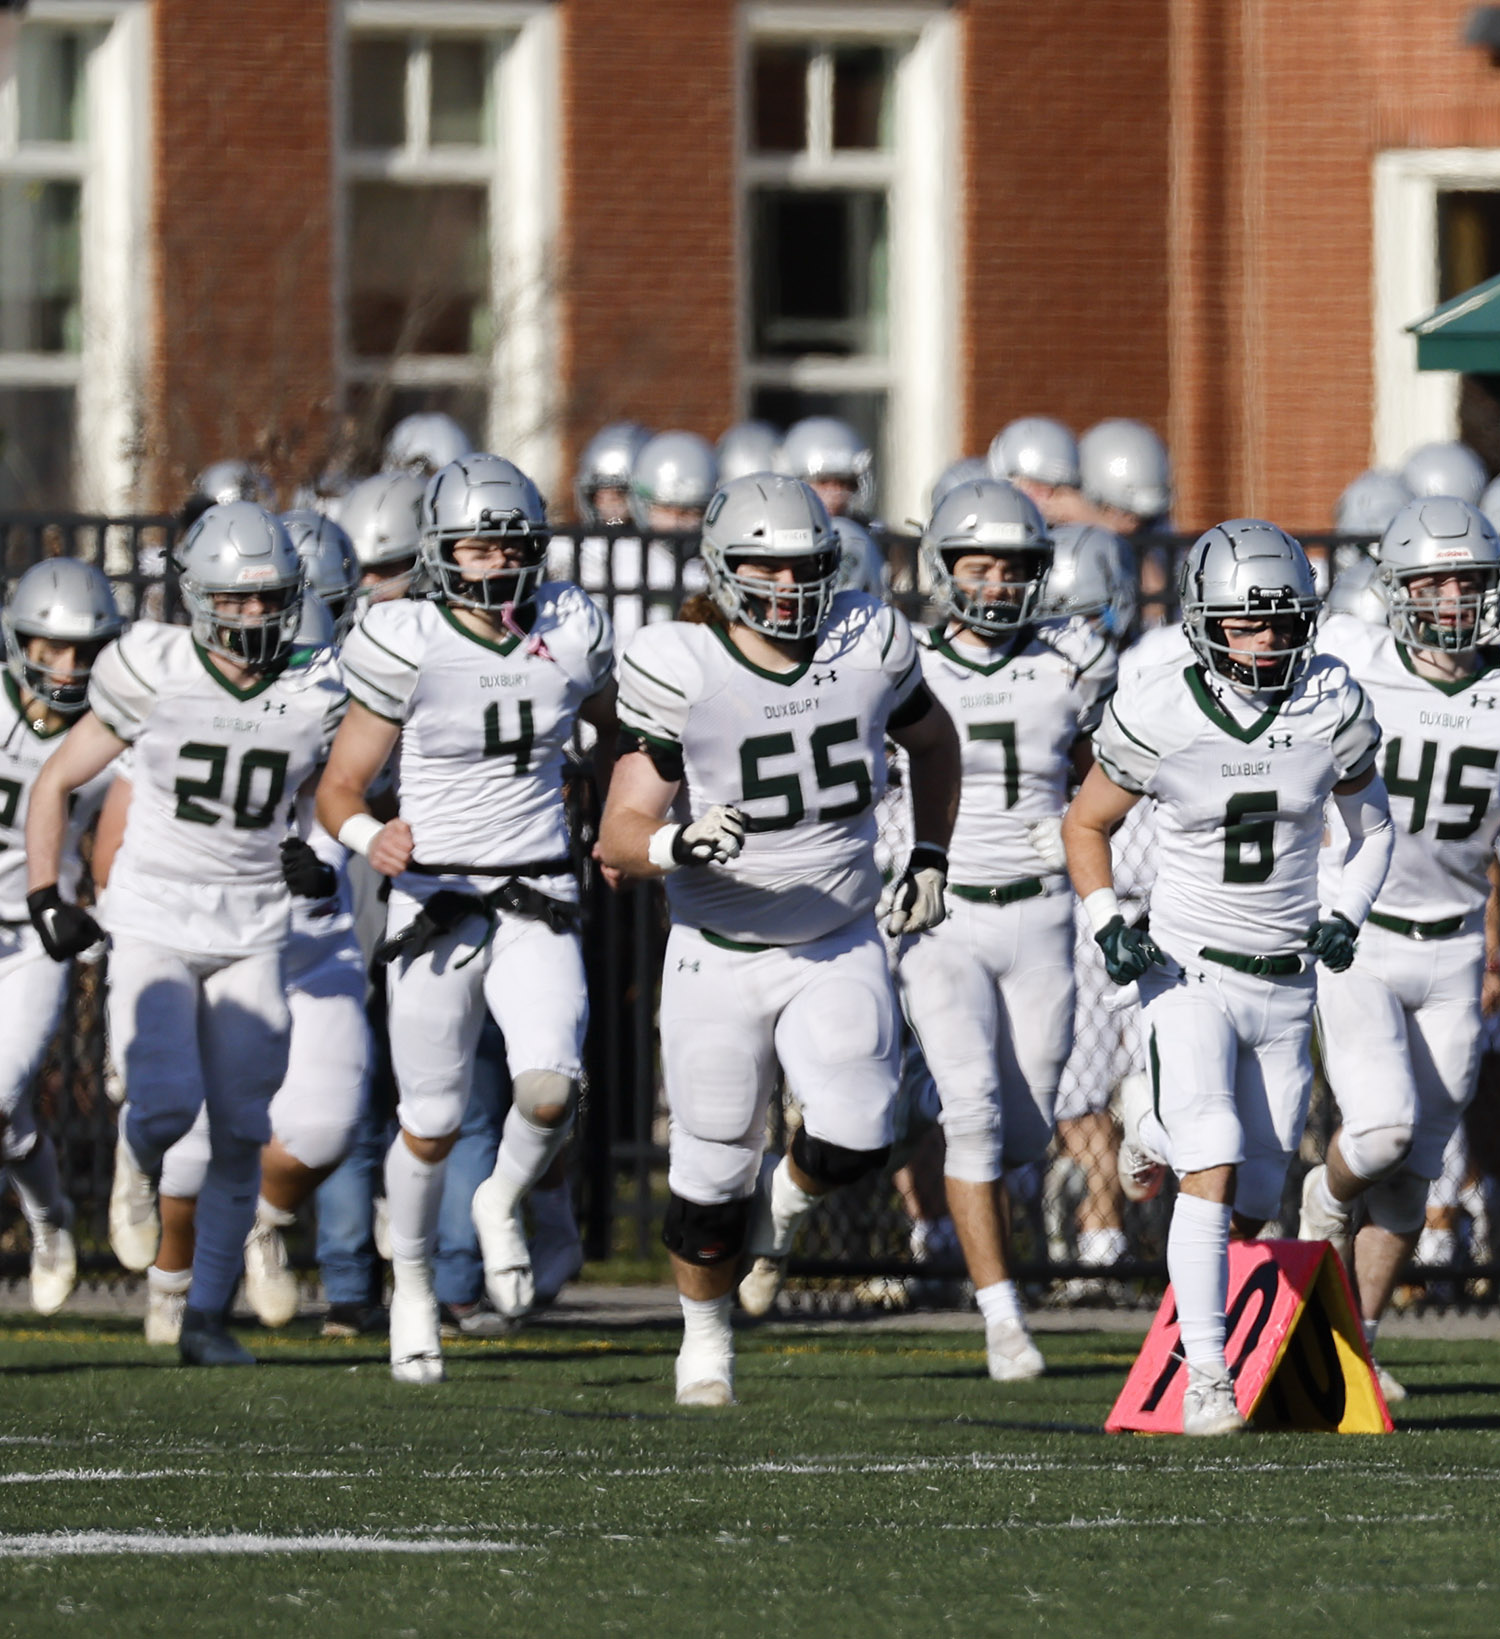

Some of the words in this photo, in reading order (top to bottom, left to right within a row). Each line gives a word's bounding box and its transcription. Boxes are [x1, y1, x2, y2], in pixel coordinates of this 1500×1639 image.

[480, 673, 528, 688] DUXBURY
[764, 697, 820, 719] DUXBURY
[1419, 710, 1472, 729] DUXBURY
[482, 699, 535, 777] 4
[738, 716, 873, 834] 55
[967, 721, 1020, 810] 7
[1221, 761, 1271, 778] DUXBURY
[173, 740, 291, 831] 20
[1382, 736, 1500, 841] 45
[1222, 789, 1279, 884] 6
